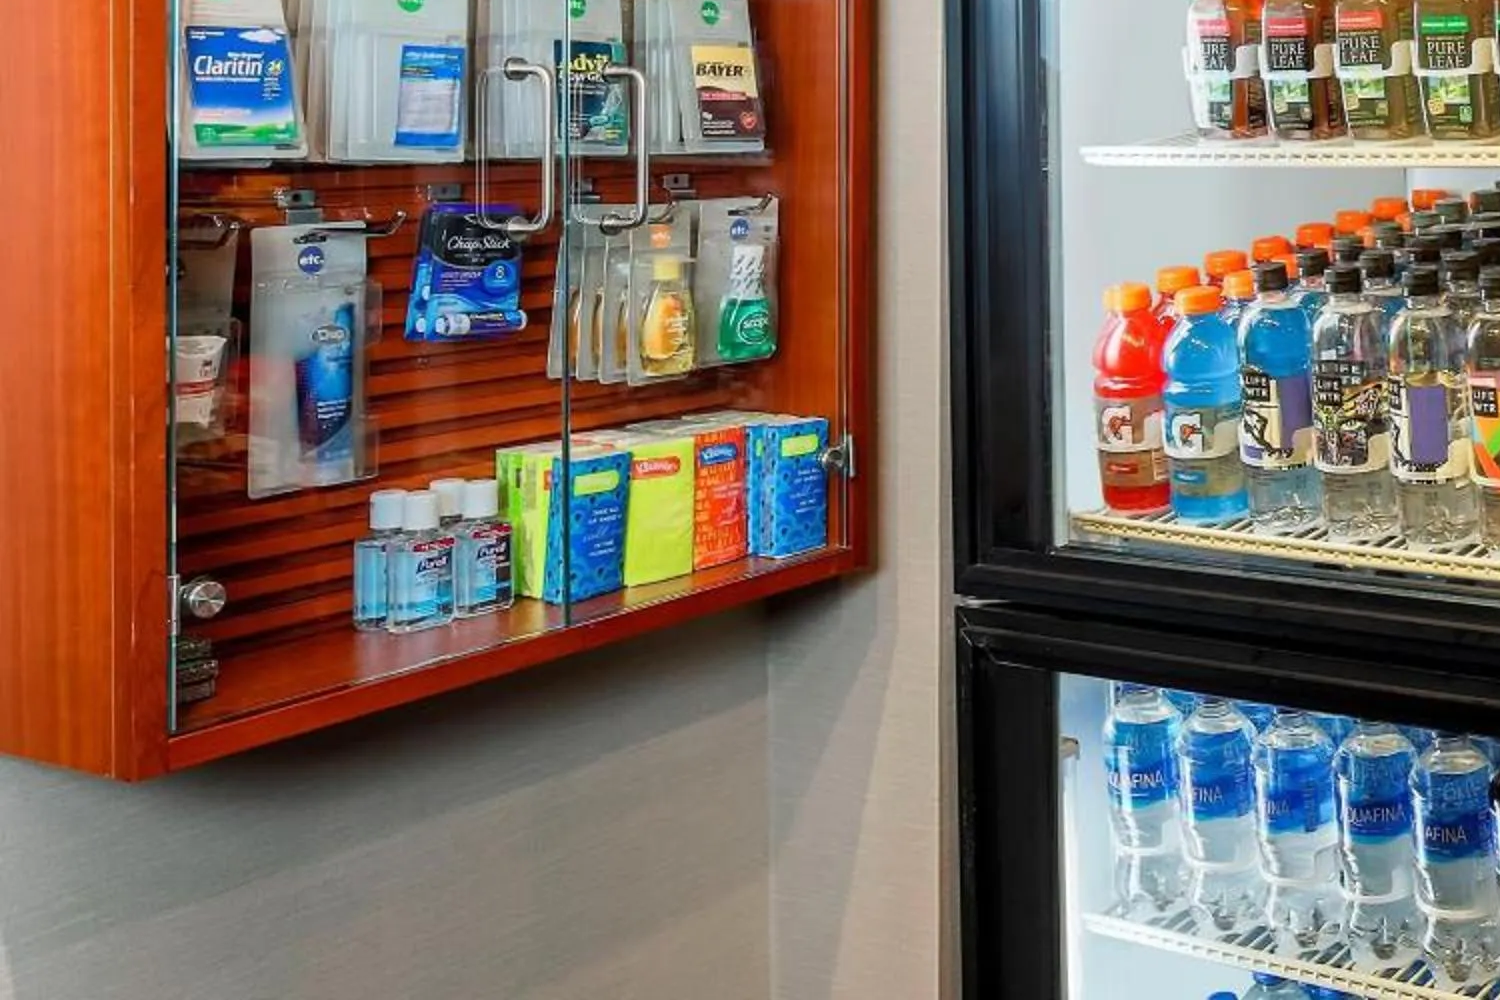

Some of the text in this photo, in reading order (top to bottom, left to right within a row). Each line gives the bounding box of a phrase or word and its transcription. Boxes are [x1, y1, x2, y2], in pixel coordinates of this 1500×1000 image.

[1271, 42, 1306, 55] PURE
[1339, 36, 1381, 50] PURE
[1427, 41, 1466, 55] PURE
[1273, 56, 1304, 69] LEAF
[1341, 49, 1378, 64] LEAF
[1429, 55, 1465, 69] LEAF
[193, 55, 264, 76] Claritin
[696, 63, 744, 77] BAYER
[1472, 390, 1496, 401] LIFE
[1474, 403, 1497, 413] WTR
